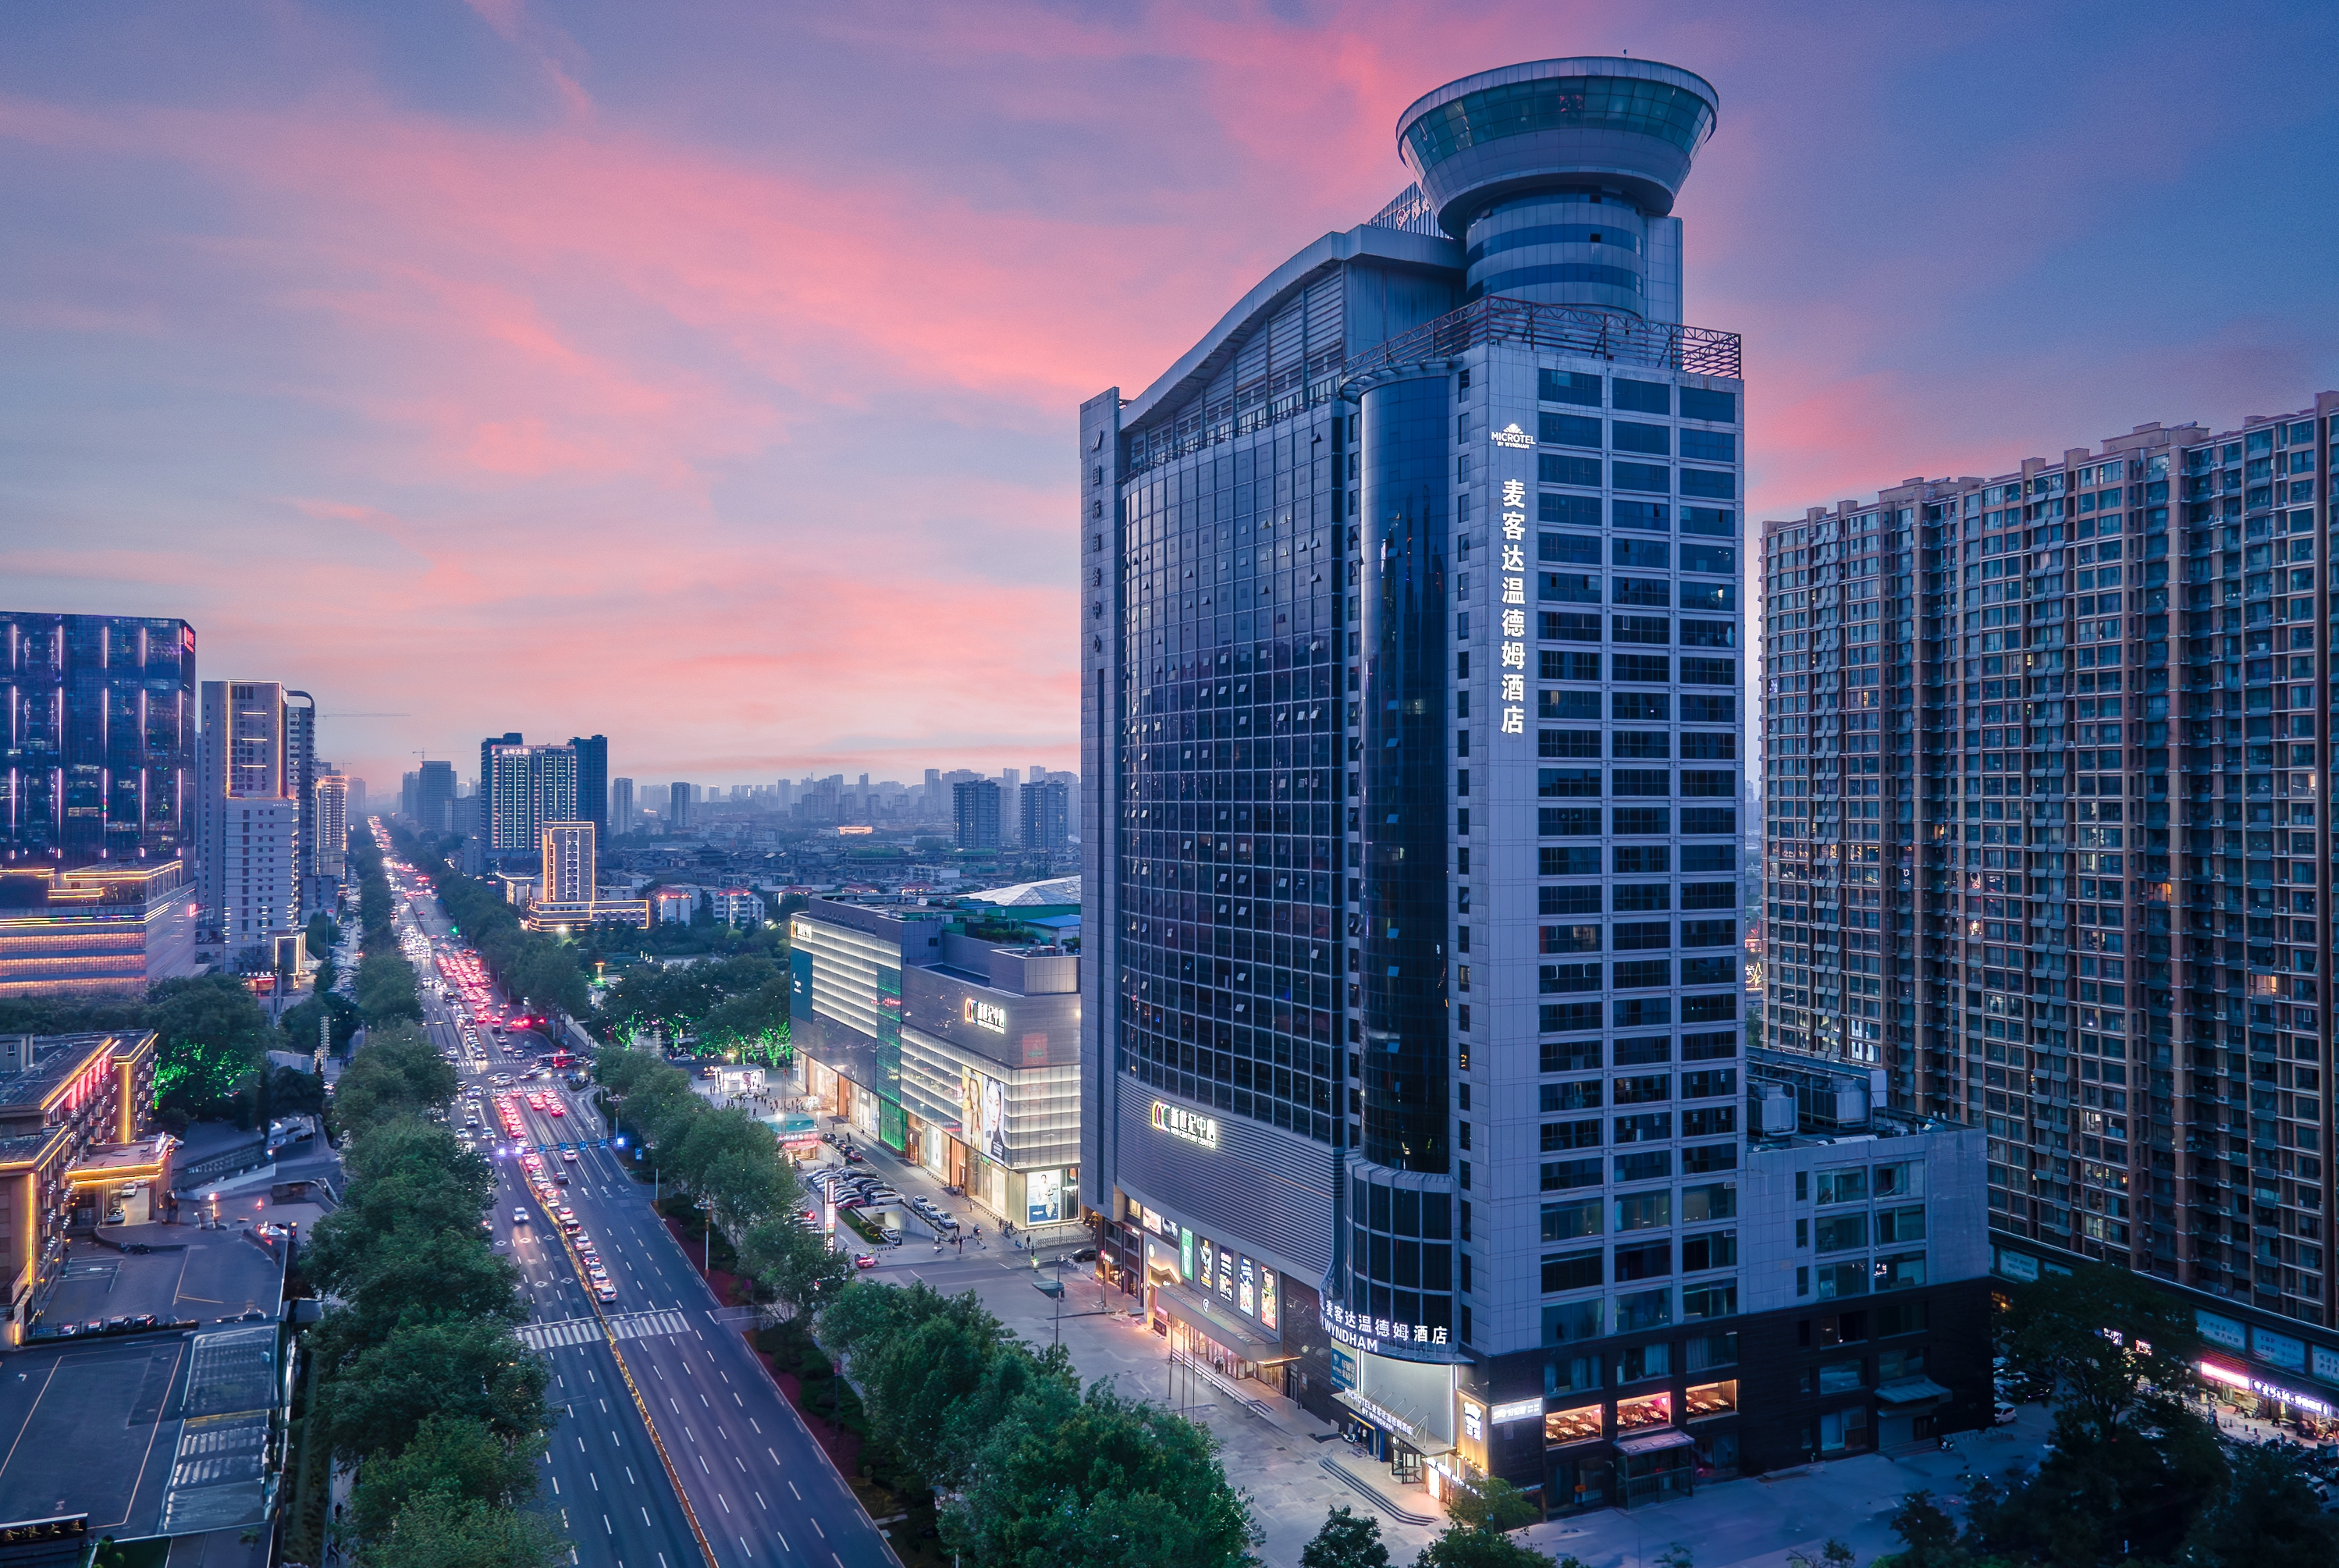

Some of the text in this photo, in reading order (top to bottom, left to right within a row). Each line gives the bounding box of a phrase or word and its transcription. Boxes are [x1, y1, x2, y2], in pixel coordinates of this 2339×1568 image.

[1491, 432, 1536, 444] MICROTEL
[1501, 478, 1526, 734] 麦客达温德姆酒店
[1324, 1317, 1378, 1353] WYNDHAM
[1326, 1300, 1448, 1345] 麦客达温德姆酒店
[1345, 1387, 1372, 1410] MICROTEL
[1369, 1412, 1394, 1433] WYNDHAM
